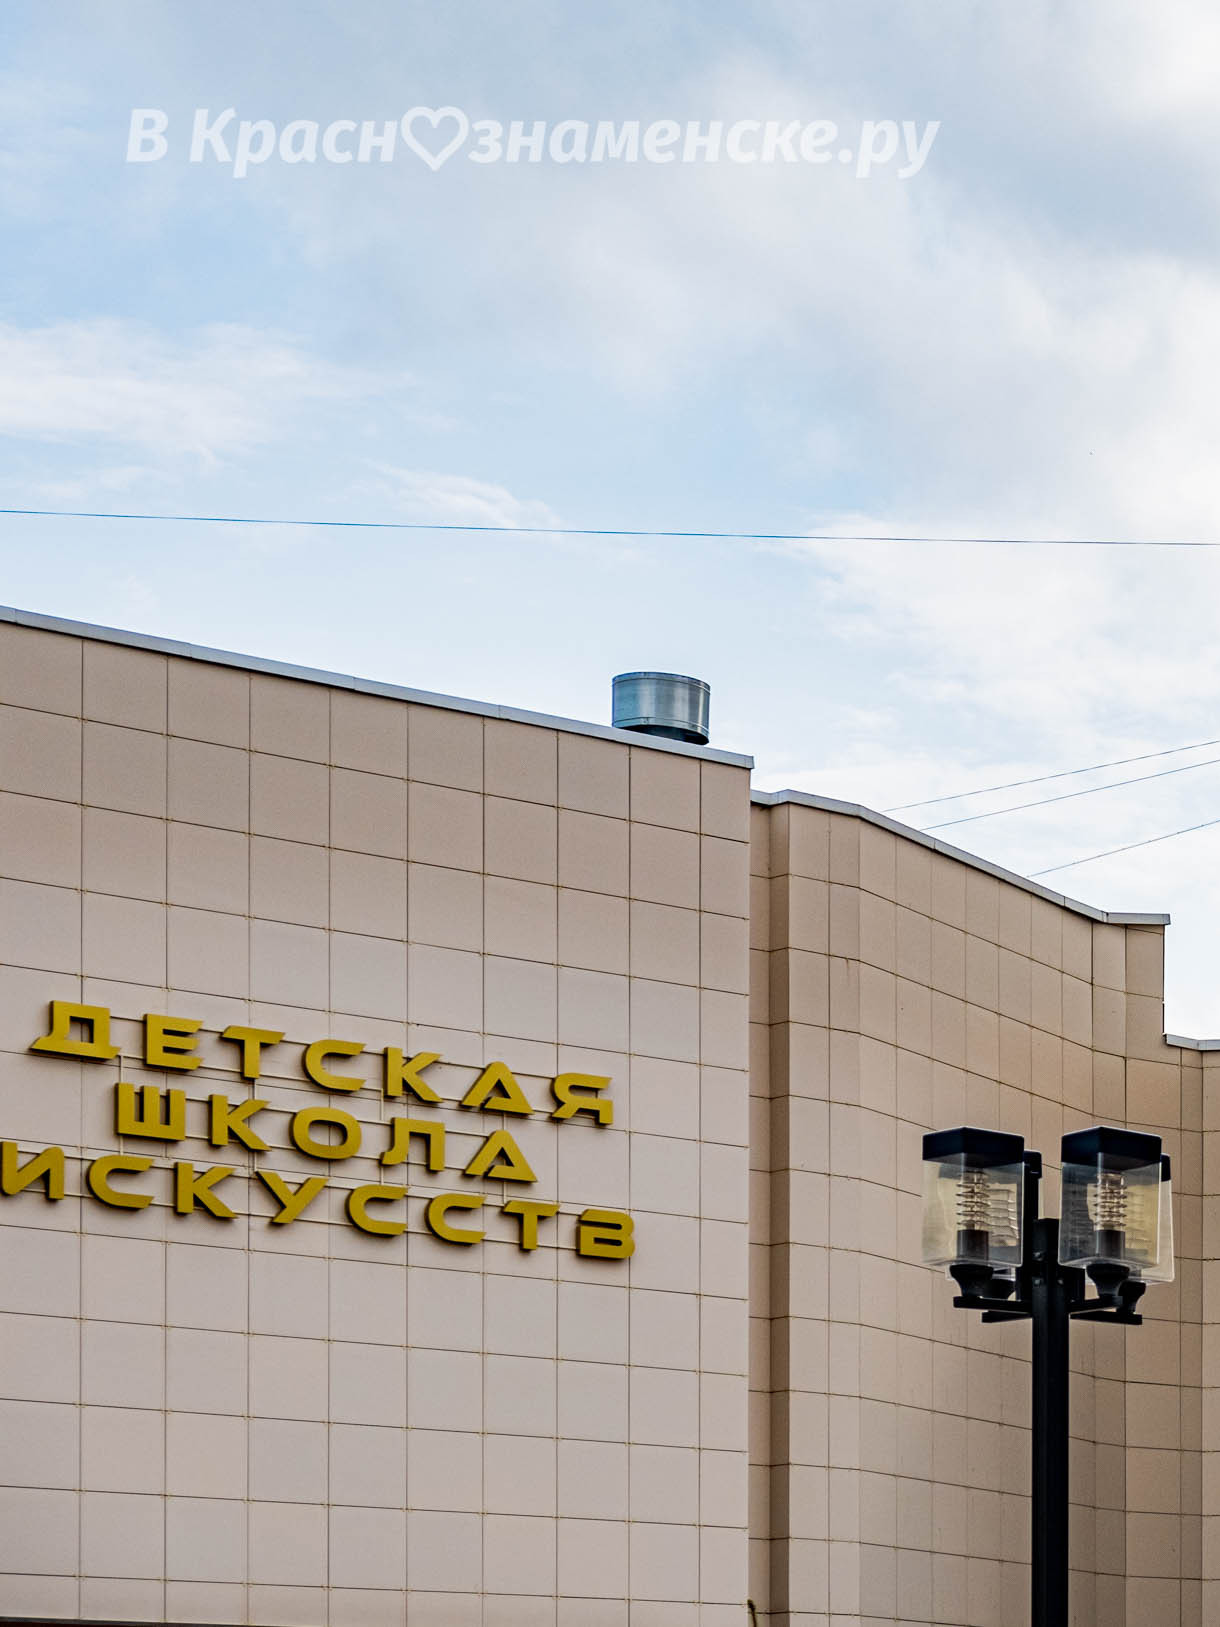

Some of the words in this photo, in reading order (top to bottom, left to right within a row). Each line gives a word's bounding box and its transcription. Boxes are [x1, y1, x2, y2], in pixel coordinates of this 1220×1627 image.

[29, 999, 614, 1126] ДЕТСКАЯ
[114, 1082, 538, 1184] ШКОЛА
[0, 1141, 636, 1261] ИСКУССТВ
